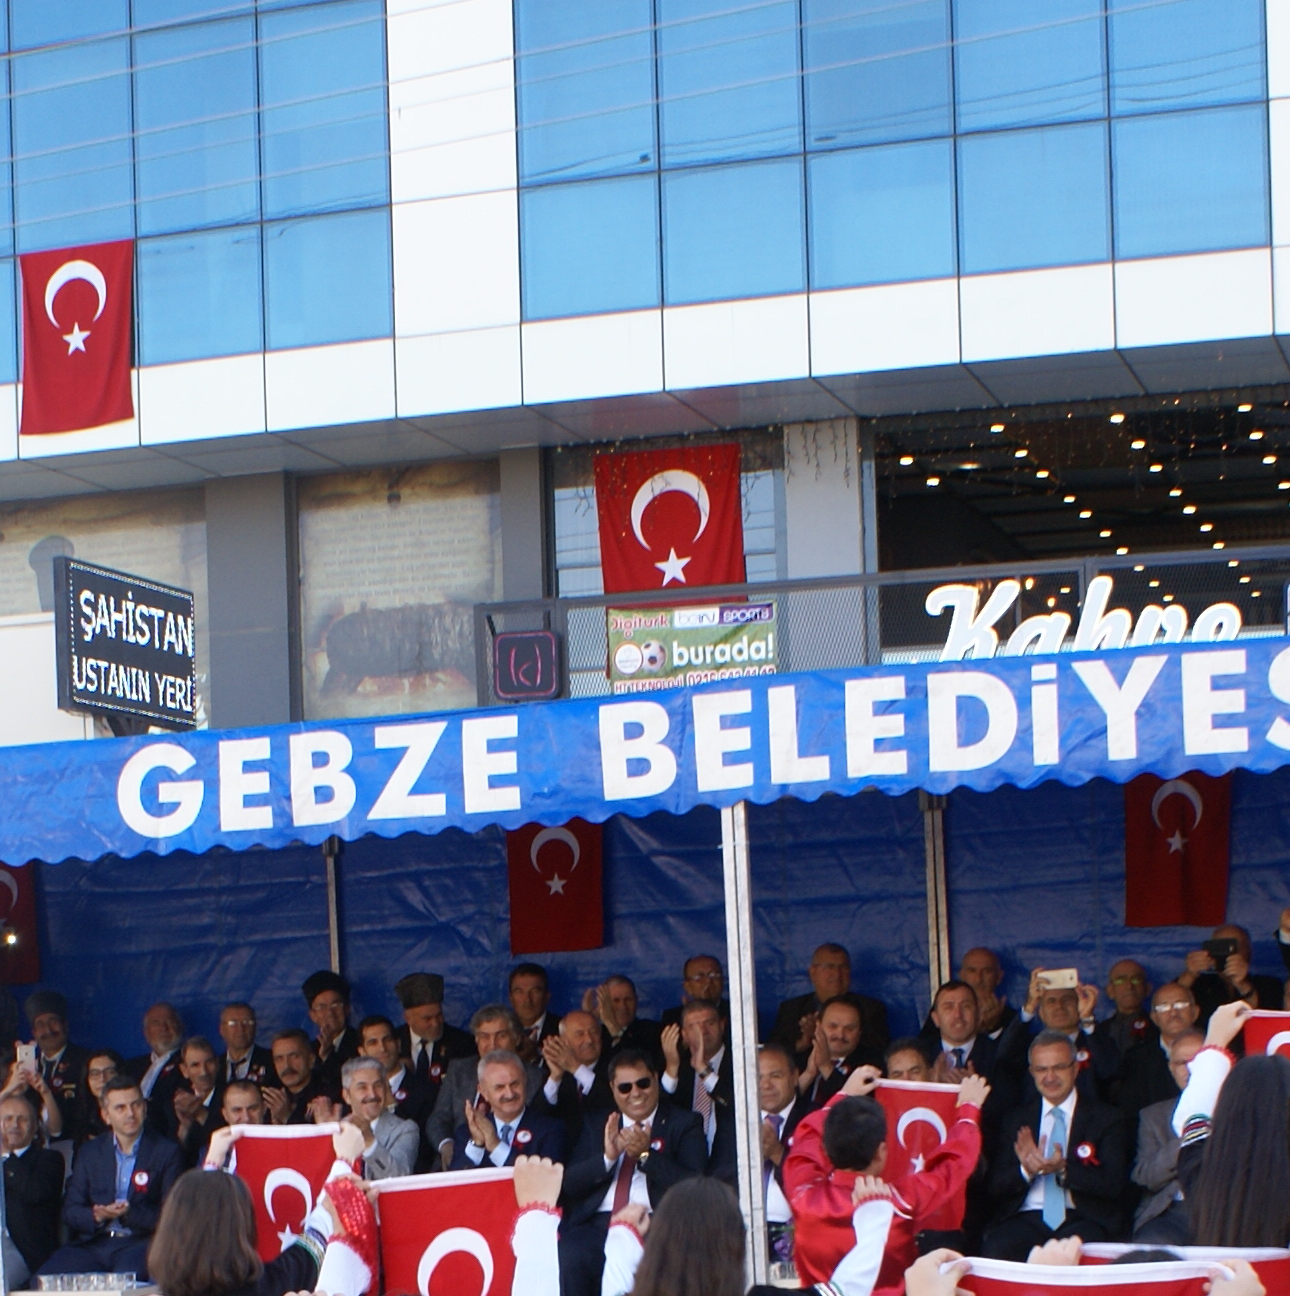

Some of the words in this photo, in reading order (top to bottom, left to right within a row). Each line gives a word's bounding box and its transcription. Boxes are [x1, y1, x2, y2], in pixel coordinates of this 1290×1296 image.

[79, 589, 193, 657] ŞAHİSTAN
[672, 633, 774, 666] burada!
[72, 655, 151, 703] USTANIN
[117, 714, 522, 838] GEBZE
